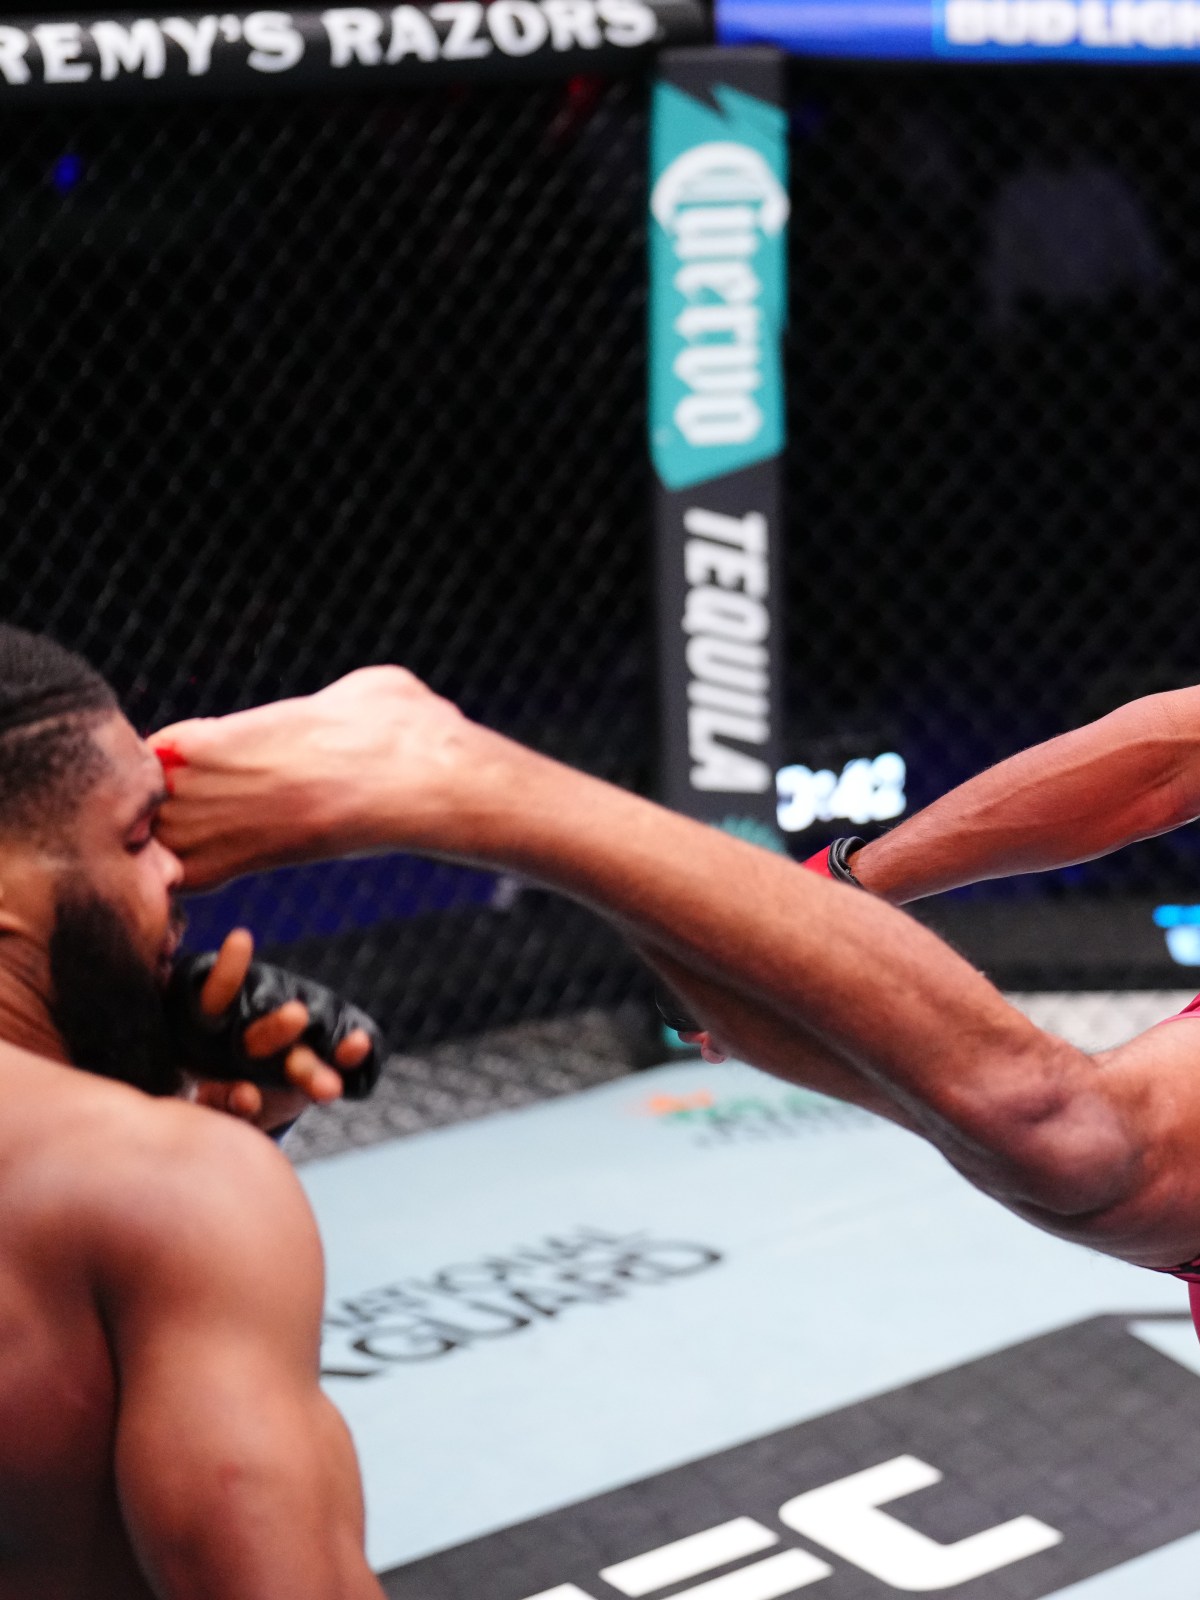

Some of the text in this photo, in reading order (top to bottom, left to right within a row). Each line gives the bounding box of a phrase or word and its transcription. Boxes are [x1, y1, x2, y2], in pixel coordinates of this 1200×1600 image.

[320, 0, 657, 68] RAZORS
[682, 507, 771, 793] TEQUILA
[352, 1241, 723, 1364] GUARD
